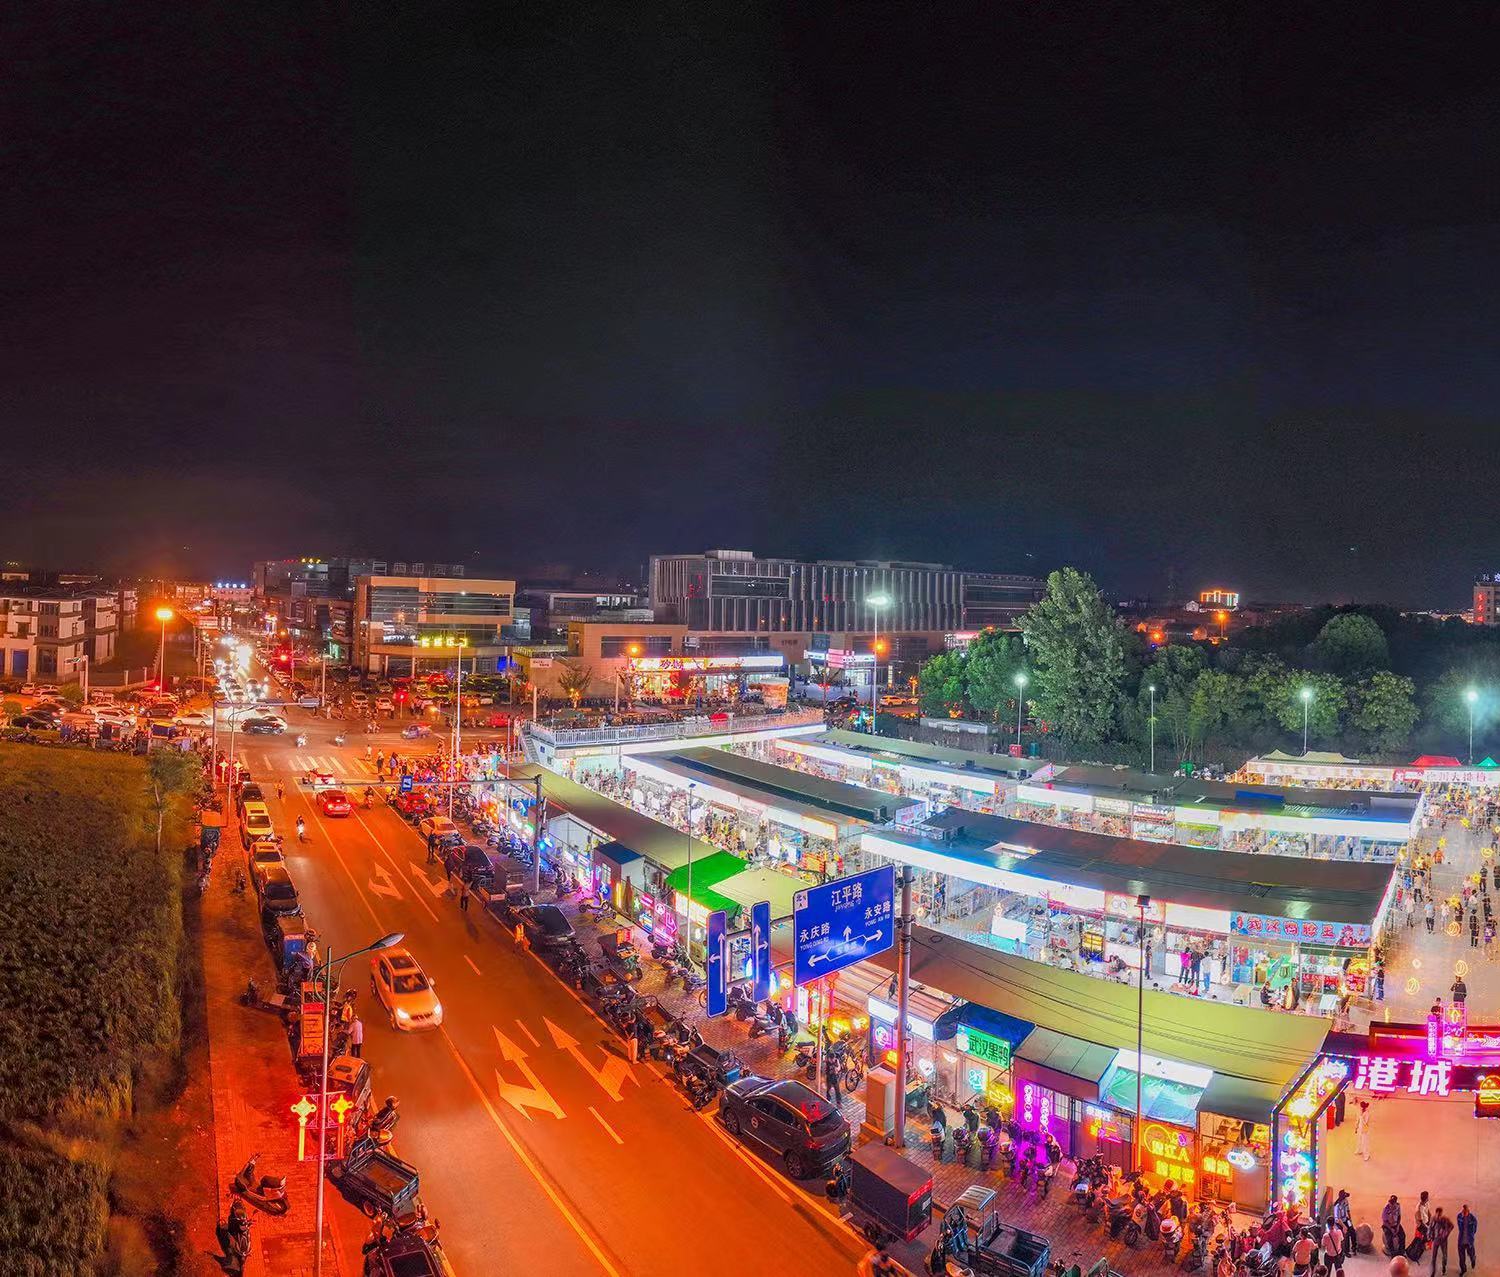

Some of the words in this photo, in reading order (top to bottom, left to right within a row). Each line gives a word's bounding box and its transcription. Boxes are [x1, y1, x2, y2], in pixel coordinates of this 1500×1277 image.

[831, 882, 863, 907] 江平路
[864, 900, 891, 920] 永安路
[799, 922, 830, 943] 永庆路
[968, 1034, 1009, 1067] 武汉黑鸭
[1354, 1056, 1452, 1097] 港城
